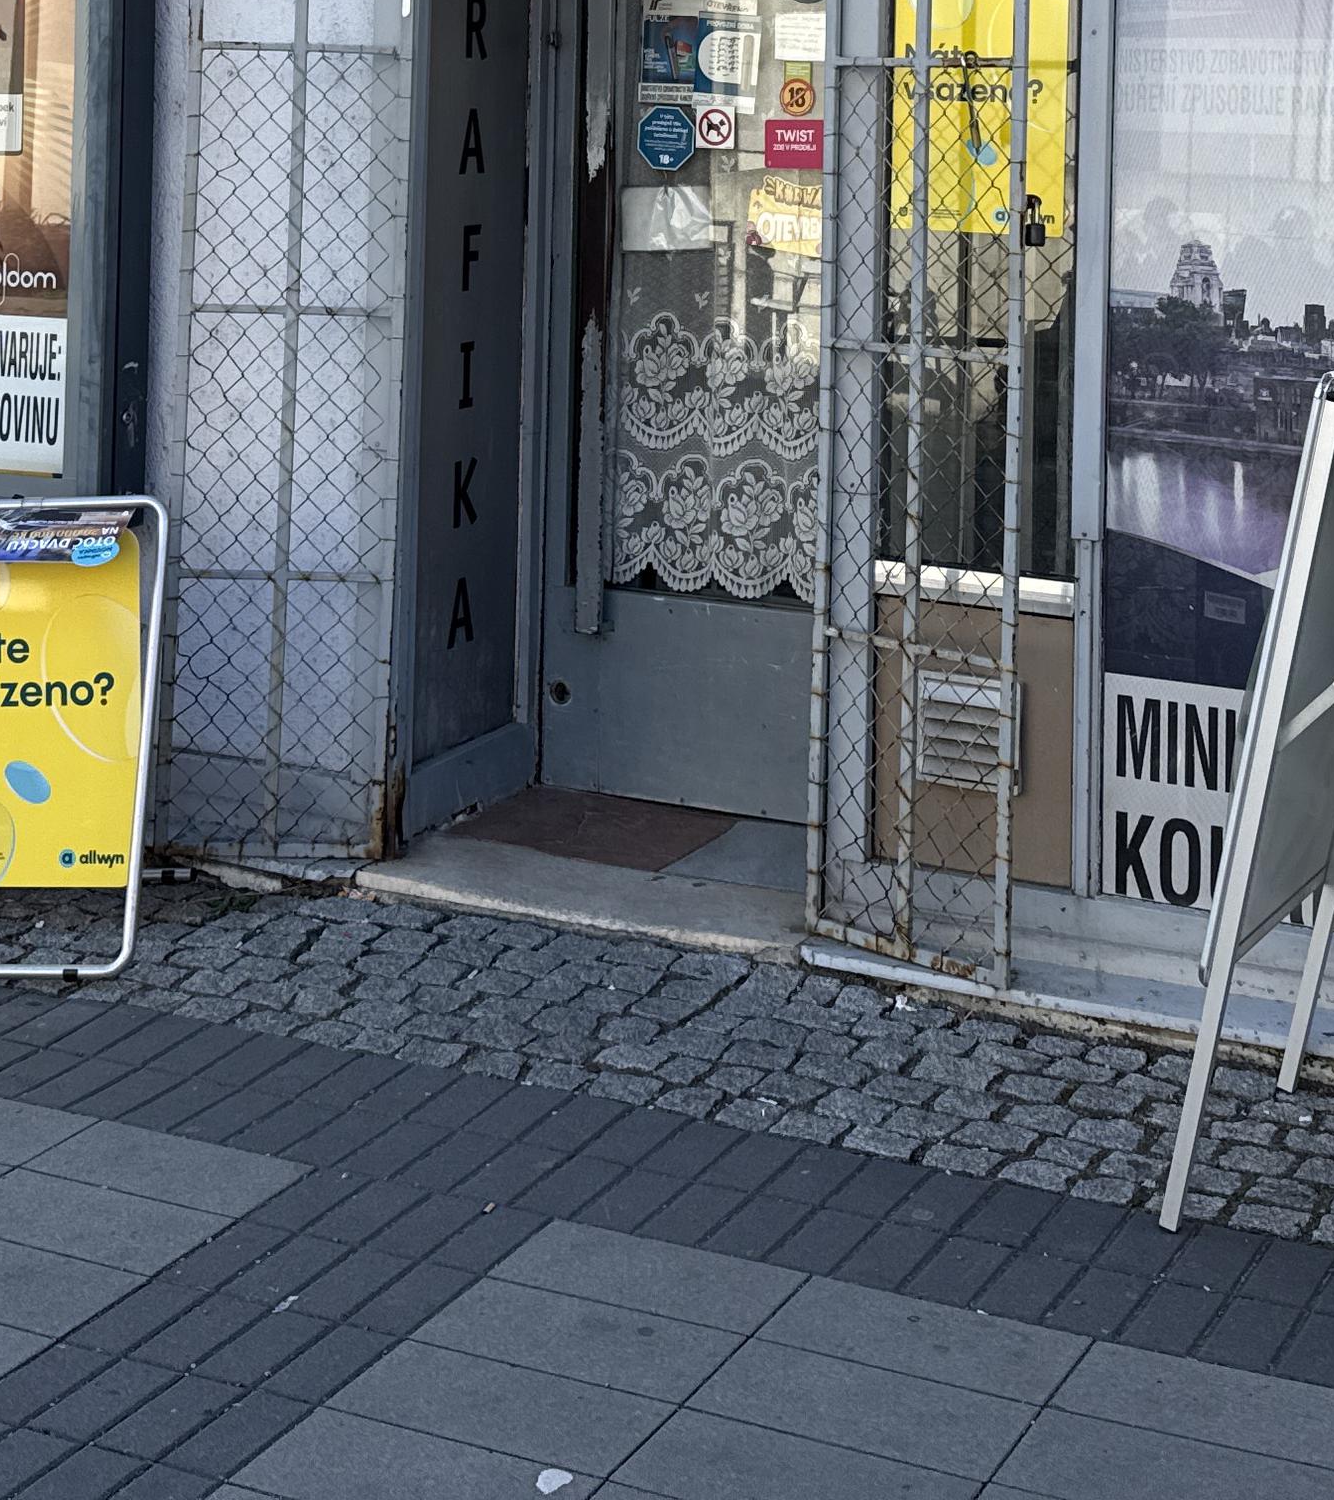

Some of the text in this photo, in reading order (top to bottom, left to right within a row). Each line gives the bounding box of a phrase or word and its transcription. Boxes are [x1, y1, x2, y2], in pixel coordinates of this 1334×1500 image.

[775, 129, 816, 143] TWIST
[0, 329, 62, 382] VARUJE:
[78, 850, 125, 869] allwyn
